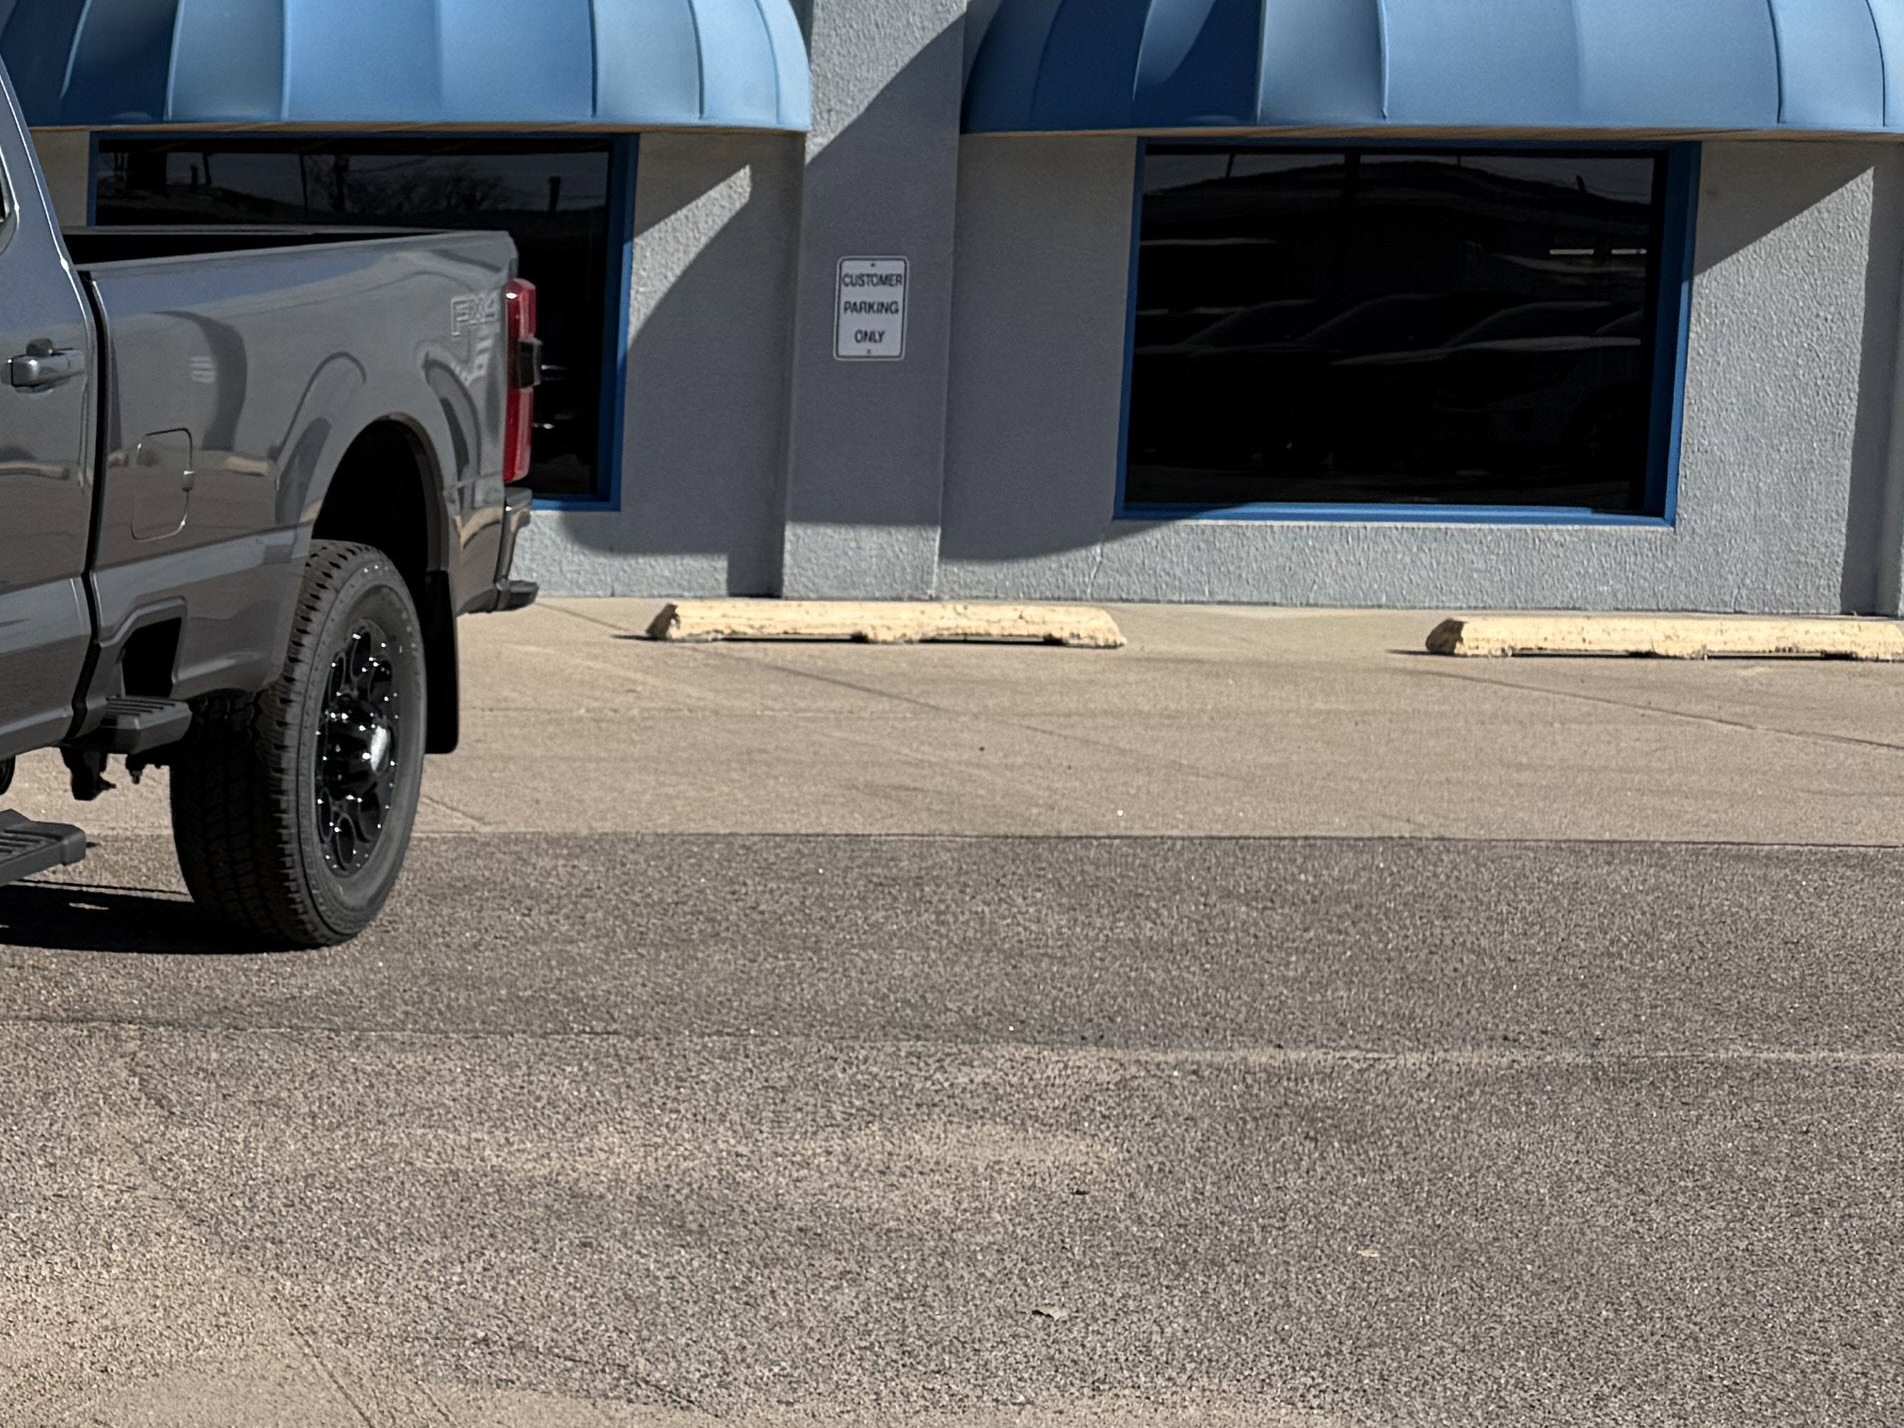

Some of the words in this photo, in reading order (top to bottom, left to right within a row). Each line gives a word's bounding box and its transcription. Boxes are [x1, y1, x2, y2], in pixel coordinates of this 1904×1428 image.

[842, 273, 903, 288] CUSTOMER
[843, 300, 900, 315] PARKING
[854, 329, 885, 344] ONLY
